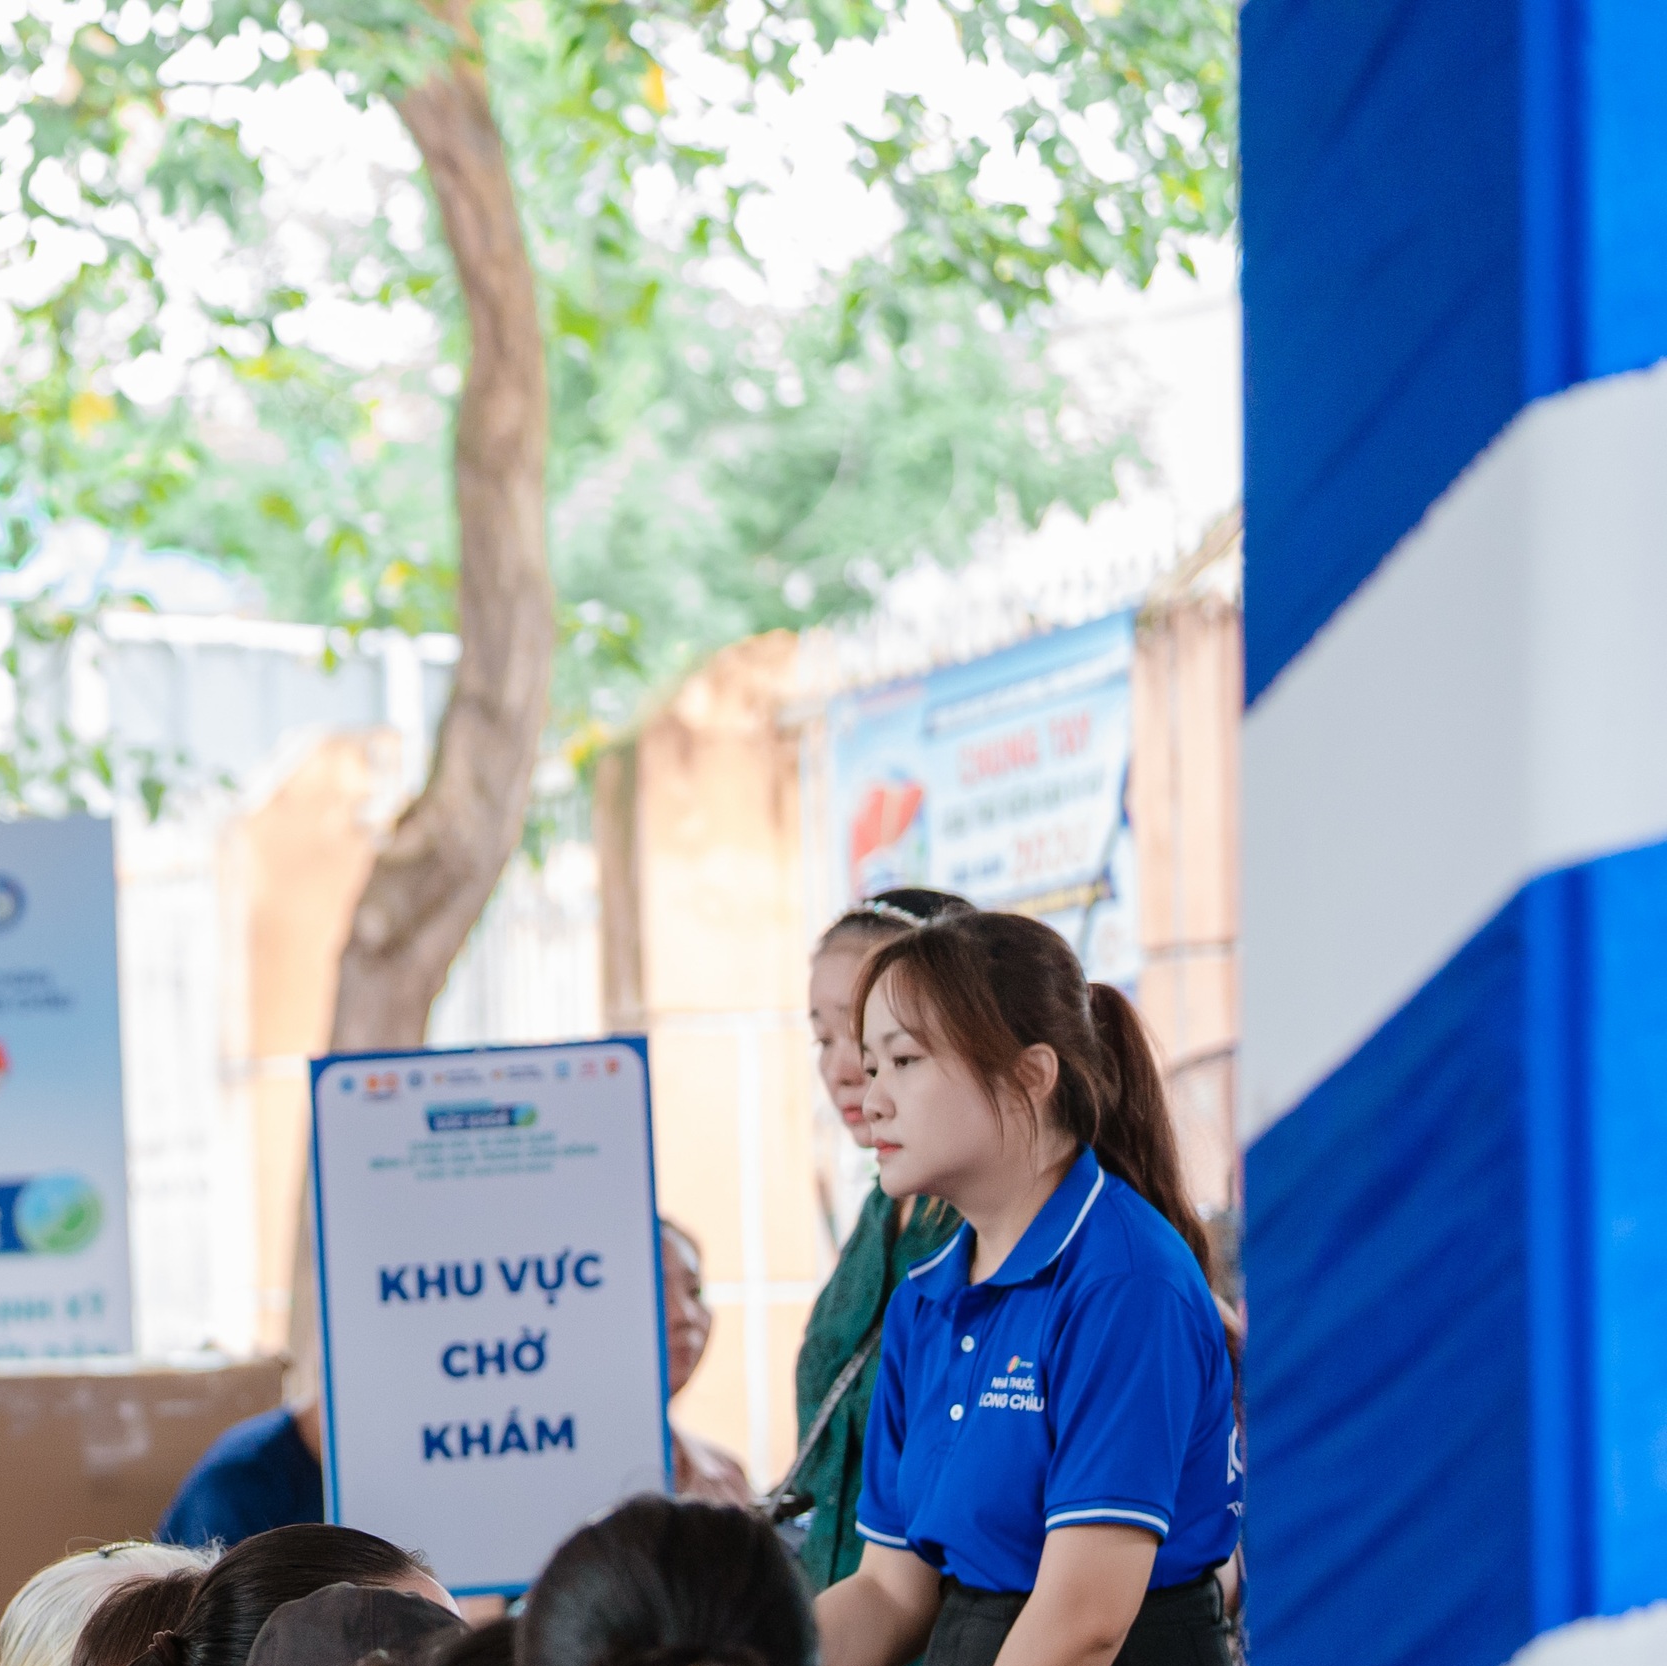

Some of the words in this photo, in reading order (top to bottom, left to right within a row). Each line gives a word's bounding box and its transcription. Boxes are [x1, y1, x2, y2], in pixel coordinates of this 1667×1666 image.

[380, 1262, 486, 1305] KHU
[498, 1249, 604, 1307] VỰC
[441, 1328, 548, 1381] CHỜ
[422, 1408, 577, 1464] KHÁM
